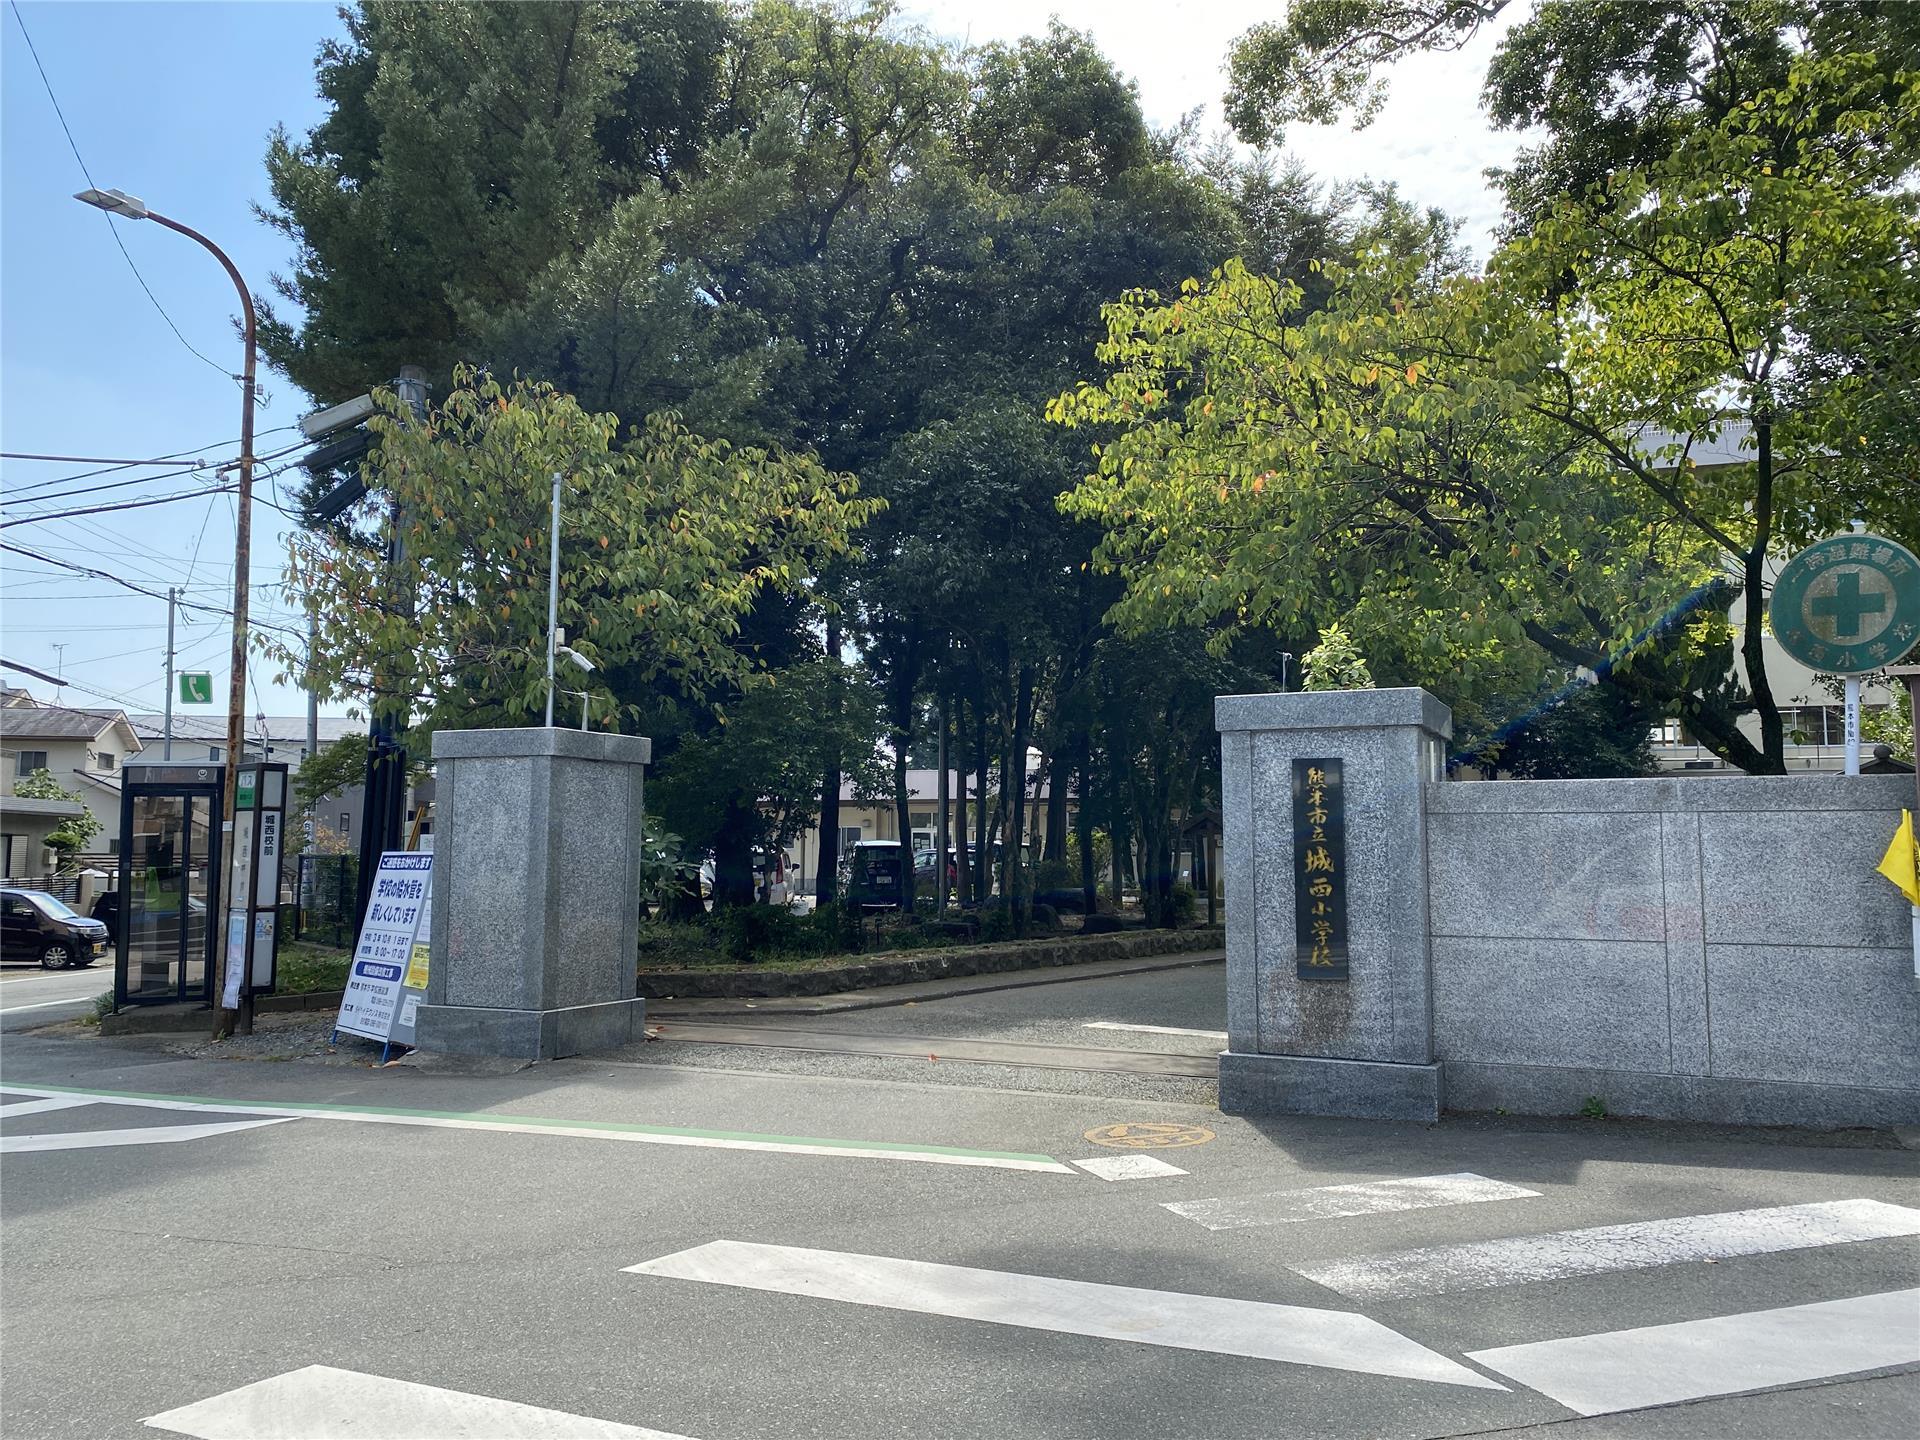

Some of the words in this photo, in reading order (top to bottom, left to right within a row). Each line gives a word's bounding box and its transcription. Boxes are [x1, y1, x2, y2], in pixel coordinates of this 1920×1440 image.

[264, 815, 275, 856] 城西校前
[1304, 767, 1335, 967] 熊本市立城西小学校
[377, 878, 423, 899] 学校の給水管を
[370, 903, 417, 925] 新しくしています
